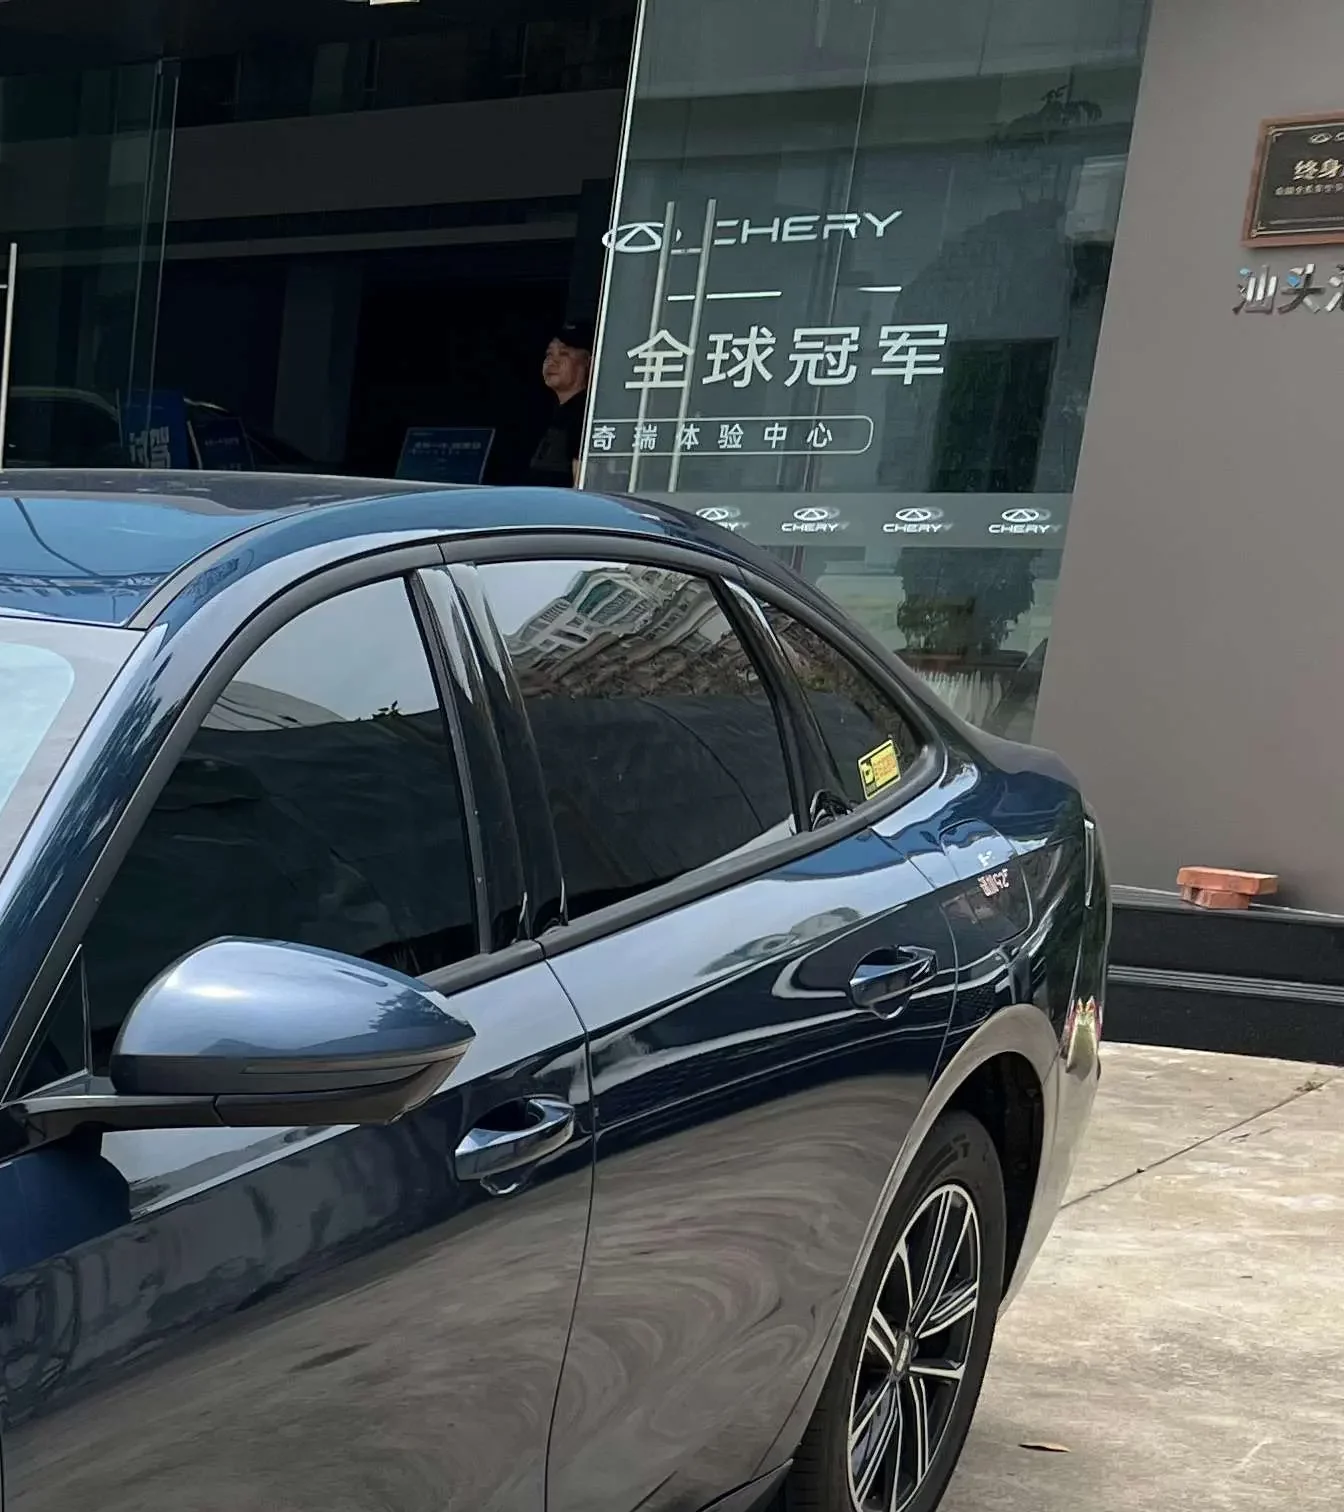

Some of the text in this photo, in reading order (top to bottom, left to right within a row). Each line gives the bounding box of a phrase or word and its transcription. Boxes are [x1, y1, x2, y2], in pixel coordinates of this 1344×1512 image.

[1293, 158, 1344, 181] 终身
[713, 210, 903, 245] CHERY
[624, 323, 949, 389] 全球冠军
[591, 421, 834, 450] 奇瑞体验中心
[781, 522, 839, 533] CHERY
[882, 522, 945, 534] CHERY
[988, 523, 1052, 535] CHERY
